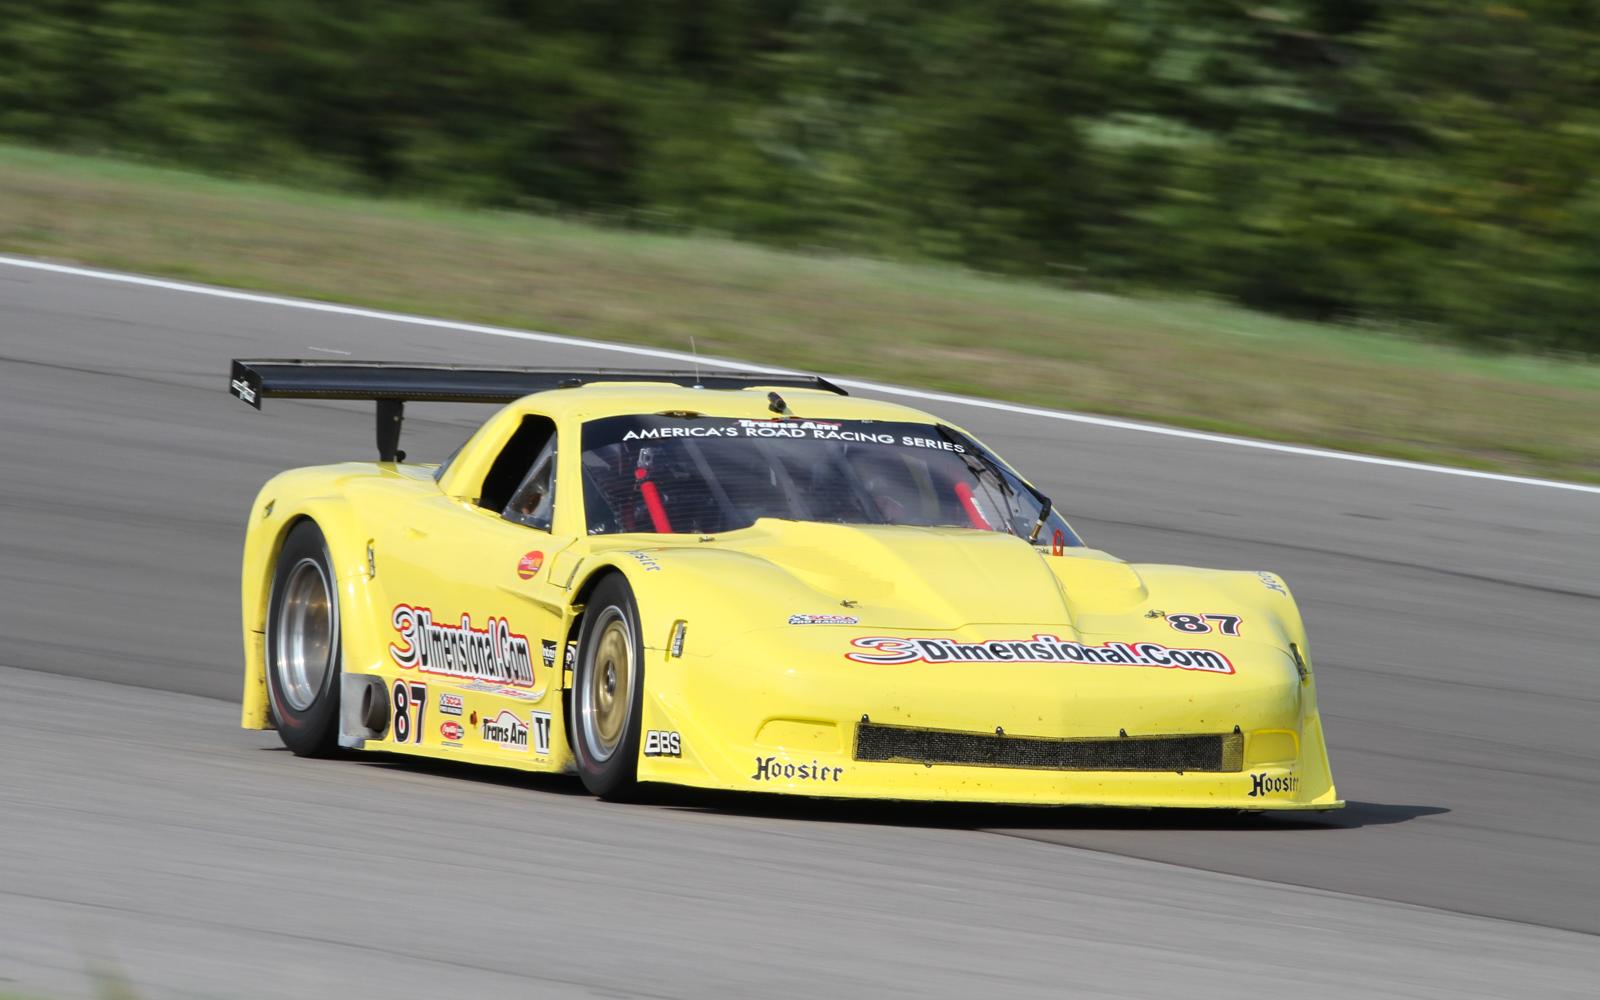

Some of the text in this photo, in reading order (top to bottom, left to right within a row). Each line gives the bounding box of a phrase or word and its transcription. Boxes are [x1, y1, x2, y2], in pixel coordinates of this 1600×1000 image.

[737, 419, 840, 431] Trans Am
[622, 427, 966, 453] AMERICA'S ROAD RACING SERIES
[1165, 613, 1243, 636] 87
[389, 603, 535, 688] 3Dimensional.Com
[845, 634, 1236, 675] 3Dimensional.Com
[392, 678, 427, 744] 87
[483, 717, 509, 743] Trans
[510, 722, 528, 746] Am
[644, 730, 682, 758] BBS
[752, 756, 844, 782] Hoosier
